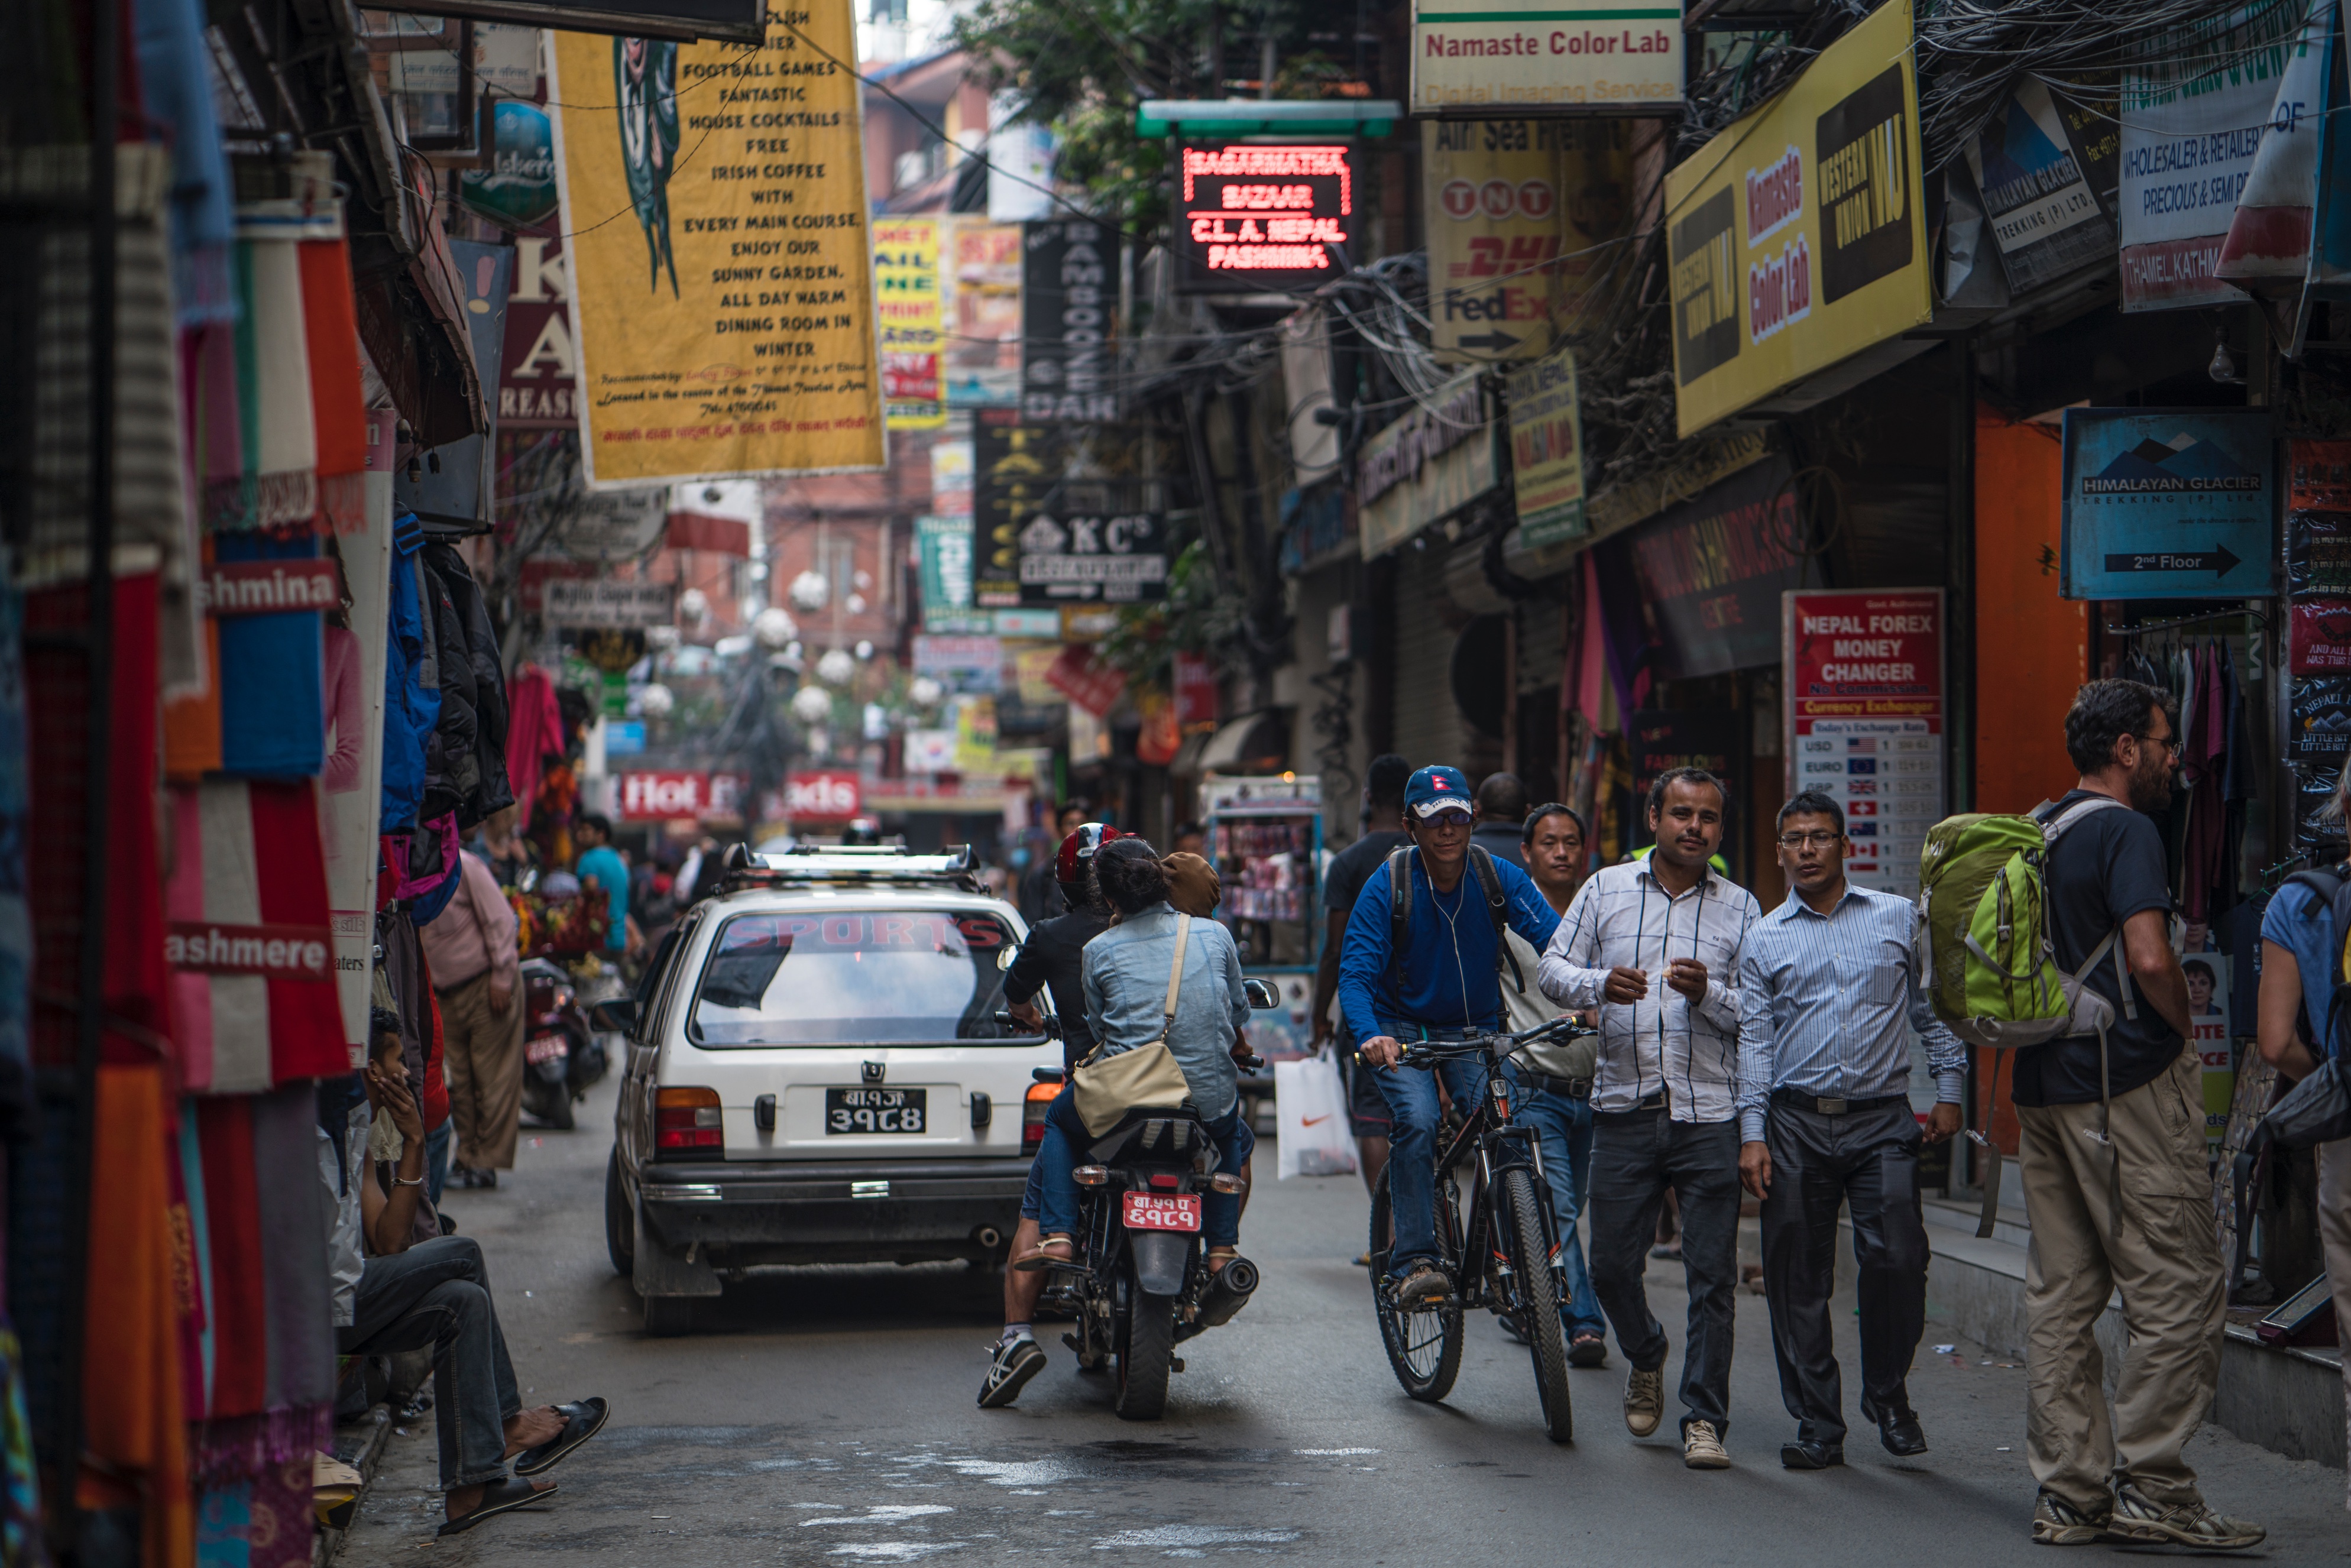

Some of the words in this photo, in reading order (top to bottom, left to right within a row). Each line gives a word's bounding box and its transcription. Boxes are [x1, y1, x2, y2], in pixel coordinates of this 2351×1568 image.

[1426, 33, 1539, 58] Namaste
[682, 63, 773, 79] FOOTBALL
[780, 61, 836, 77] GAMES
[719, 88, 805, 103] FANTASTIC
[1426, 82, 1493, 105] Digital
[1500, 81, 1586, 103] Imaging
[1593, 79, 1675, 99] Service
[689, 115, 743, 130] HOUSE
[751, 112, 840, 128] COCKTAILS
[2275, 102, 2305, 133] OF
[746, 139, 789, 154] FREE
[2123, 142, 2198, 177] WHOLESALER
[2200, 136, 2208, 167] &
[2211, 128, 2259, 164] RETAILER
[711, 166, 757, 181] IRISH
[763, 164, 825, 179] COFFEE
[1819, 135, 1869, 207] WESTERN
[1870, 112, 1905, 230] WU
[1983, 173, 2039, 215] HIMALAYAN
[2036, 155, 2080, 193] GLACIER
[752, 190, 794, 204] WITH
[1222, 184, 1314, 209] BAZAR
[1446, 182, 1550, 216] TNT
[1746, 149, 1802, 242] Namaste
[2143, 179, 2197, 216] PRECIOUS
[2199, 179, 2207, 206] &
[2210, 174, 2233, 205] SEMI
[684, 217, 737, 233] EVERY
[746, 216, 787, 231] MAIN
[1835, 187, 1871, 250] UNION
[1996, 210, 2046, 242] TREKKING
[2048, 202, 2066, 225] (P)
[2068, 192, 2093, 213] LTD.
[731, 242, 781, 257] ENJOY
[787, 240, 820, 255] OUR
[1209, 244, 1329, 269] PASHMINA
[713, 268, 762, 283] SUNNY
[770, 265, 844, 281] GARDEN.
[1750, 255, 1785, 339] Color
[1785, 237, 1811, 320] Lab
[720, 293, 752, 307] ALL
[759, 291, 790, 306] DAY
[796, 290, 846, 304] WARM
[1444, 287, 1548, 320] FedEx
[715, 318, 773, 334] DINING
[781, 316, 828, 331] ROOM
[834, 314, 851, 329] IN
[754, 341, 815, 357] WINTER
[2084, 477, 2184, 492] HIMALAYAN
[2190, 476, 2260, 490] GLACIER
[2083, 495, 2174, 505] TREKKING
[2188, 495, 2213, 505] (P)
[2227, 493, 2262, 503] Ltd.
[2133, 555, 2156, 569] 2nd
[2160, 554, 2202, 569] Floor
[1803, 615, 1865, 635] NEPAL
[1869, 614, 1933, 634] FOREX
[1834, 639, 1903, 659] MONEY
[2309, 644, 2330, 654] AND
[2330, 646, 2346, 655] ALL
[2306, 655, 2325, 664] WAS
[2327, 655, 2346, 665] THIS
[1821, 662, 1916, 683] CHANGER
[1809, 683, 1830, 695] No
[1835, 682, 1929, 695] Commission
[1805, 700, 1863, 715] Currency
[1865, 699, 1934, 716] Exchanger
[1815, 723, 1852, 733] Today's
[1854, 723, 1900, 734] Exchange
[1903, 722, 1926, 732] Rate
[1805, 741, 1832, 751] USD
[2301, 743, 2331, 751] LITTLE
[2332, 743, 2347, 751] BIT
[2302, 733, 2333, 743] LITTLE
[2334, 733, 2349, 742] BIT
[1805, 761, 1842, 772] EURO
[624, 773, 698, 814] Hot
[1805, 782, 1833, 793] GBP
[1432, 798, 1464, 808] NEPAL
[340, 916, 366, 932] silk
[727, 916, 1002, 947] SPORTS
[831, 1107, 922, 1132] ३१८४
